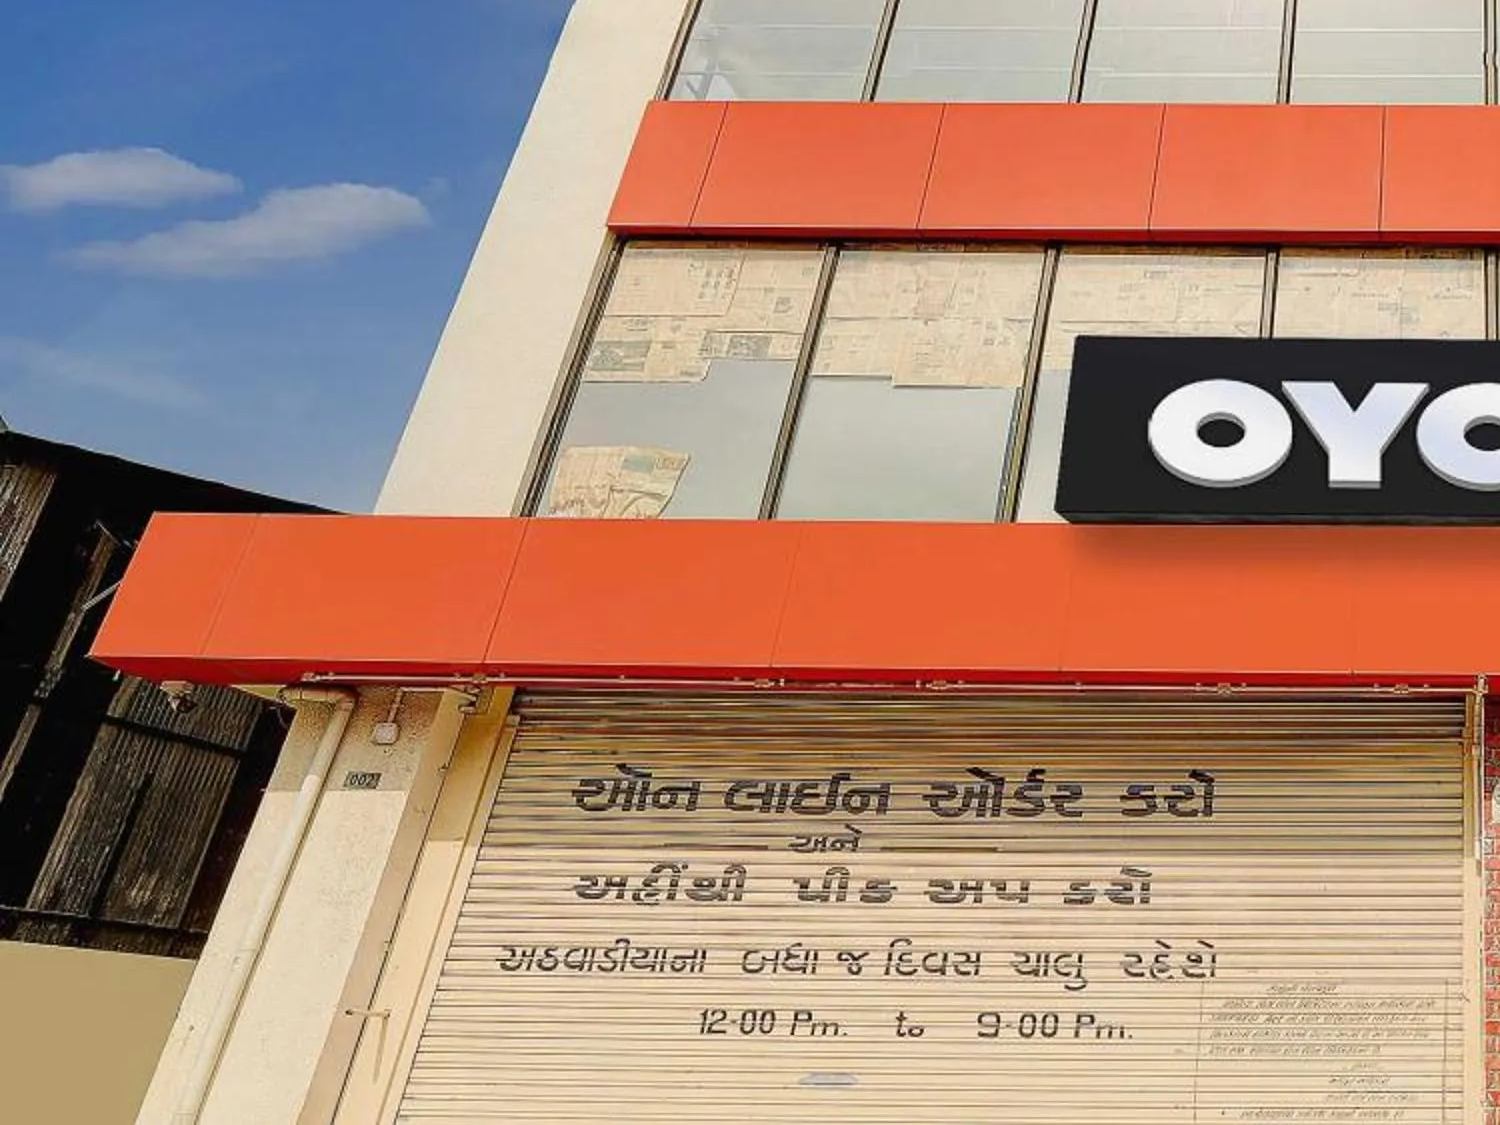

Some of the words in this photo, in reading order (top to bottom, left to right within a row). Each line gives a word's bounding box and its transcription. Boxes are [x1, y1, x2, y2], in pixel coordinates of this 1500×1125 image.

[1120, 769, 1216, 818] કરો
[788, 824, 863, 853] અને
[572, 862, 748, 905] અહીંથી
[792, 866, 898, 904] પીક
[923, 878, 1031, 905] અપ
[1061, 866, 1153, 905] કરો
[741, 942, 820, 975] બધા
[837, 951, 869, 976] જ
[884, 938, 982, 976] દિવસ
[1009, 951, 1088, 991] ચાલુ
[1119, 939, 1218, 980] રહેશે
[895, 1011, 925, 1038] to
